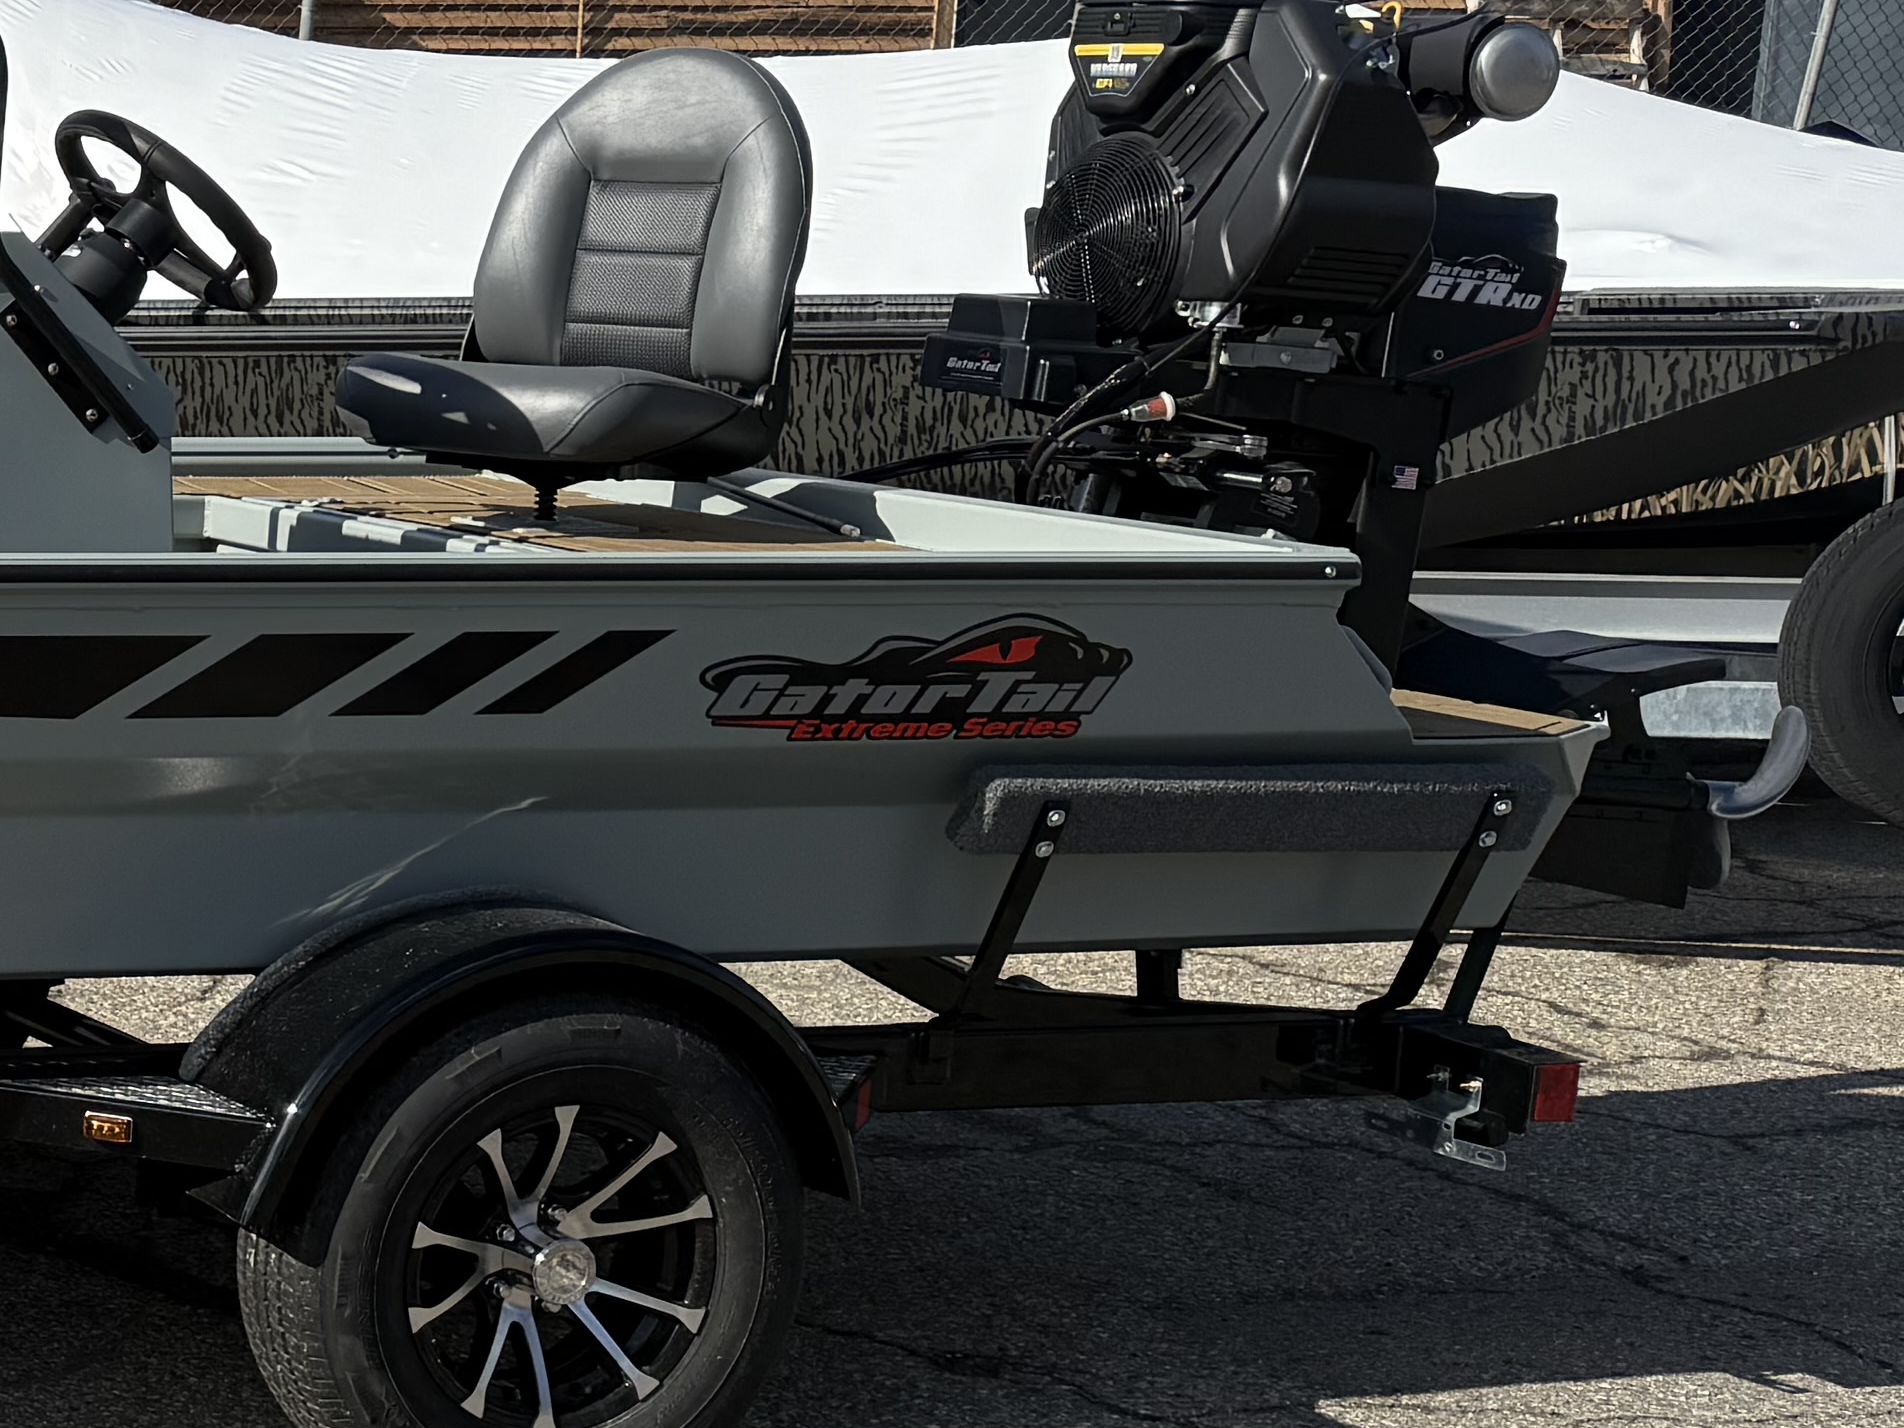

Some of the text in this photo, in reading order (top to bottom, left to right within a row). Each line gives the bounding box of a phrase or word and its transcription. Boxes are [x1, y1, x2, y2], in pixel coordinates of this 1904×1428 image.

[708, 669, 1122, 718] GatorTail
[790, 715, 1080, 740] Extreme Series
